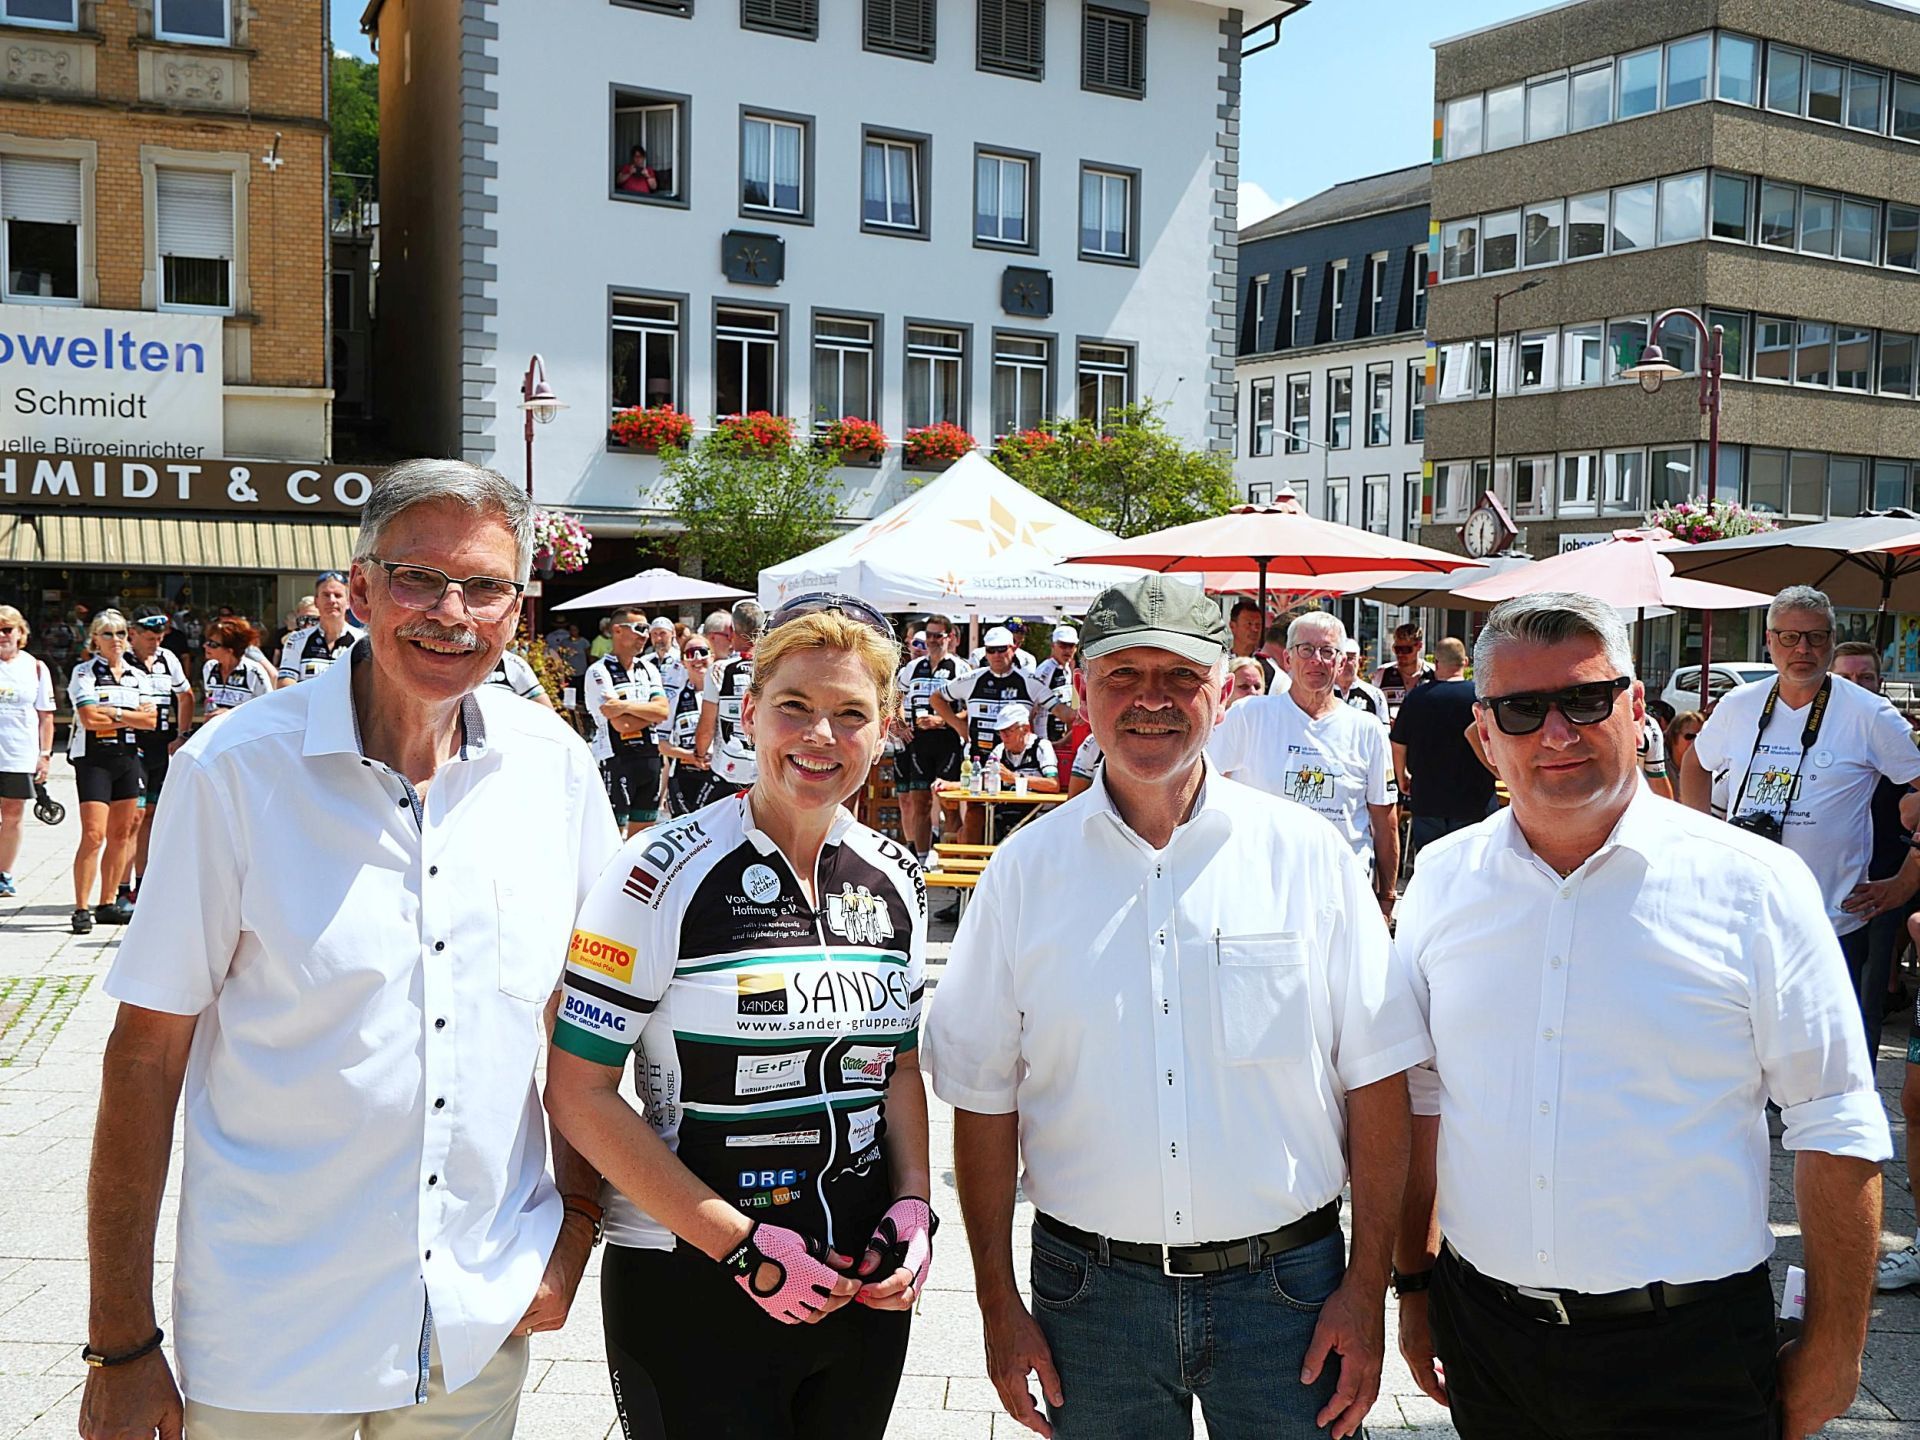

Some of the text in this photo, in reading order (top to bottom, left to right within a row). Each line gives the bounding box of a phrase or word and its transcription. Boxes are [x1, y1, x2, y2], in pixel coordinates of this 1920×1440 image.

[15, 387, 147, 418] Schmidt
[54, 436, 205, 458] Büroeinrichter
[227, 466, 259, 502] &
[286, 469, 373, 506] CO
[1025, 576, 1080, 589] Morsch
[1808, 709, 1822, 731] Nikon
[652, 880, 671, 910] Deutsche
[666, 855, 691, 882] Fertighaus
[689, 843, 708, 858] Holding
[732, 904, 799, 917] Hoffnung e.V.
[582, 938, 630, 967] LOTTO
[565, 995, 626, 1032] BOMAG
[741, 1000, 785, 1012] SANDER
[578, 1017, 601, 1030] GROUP
